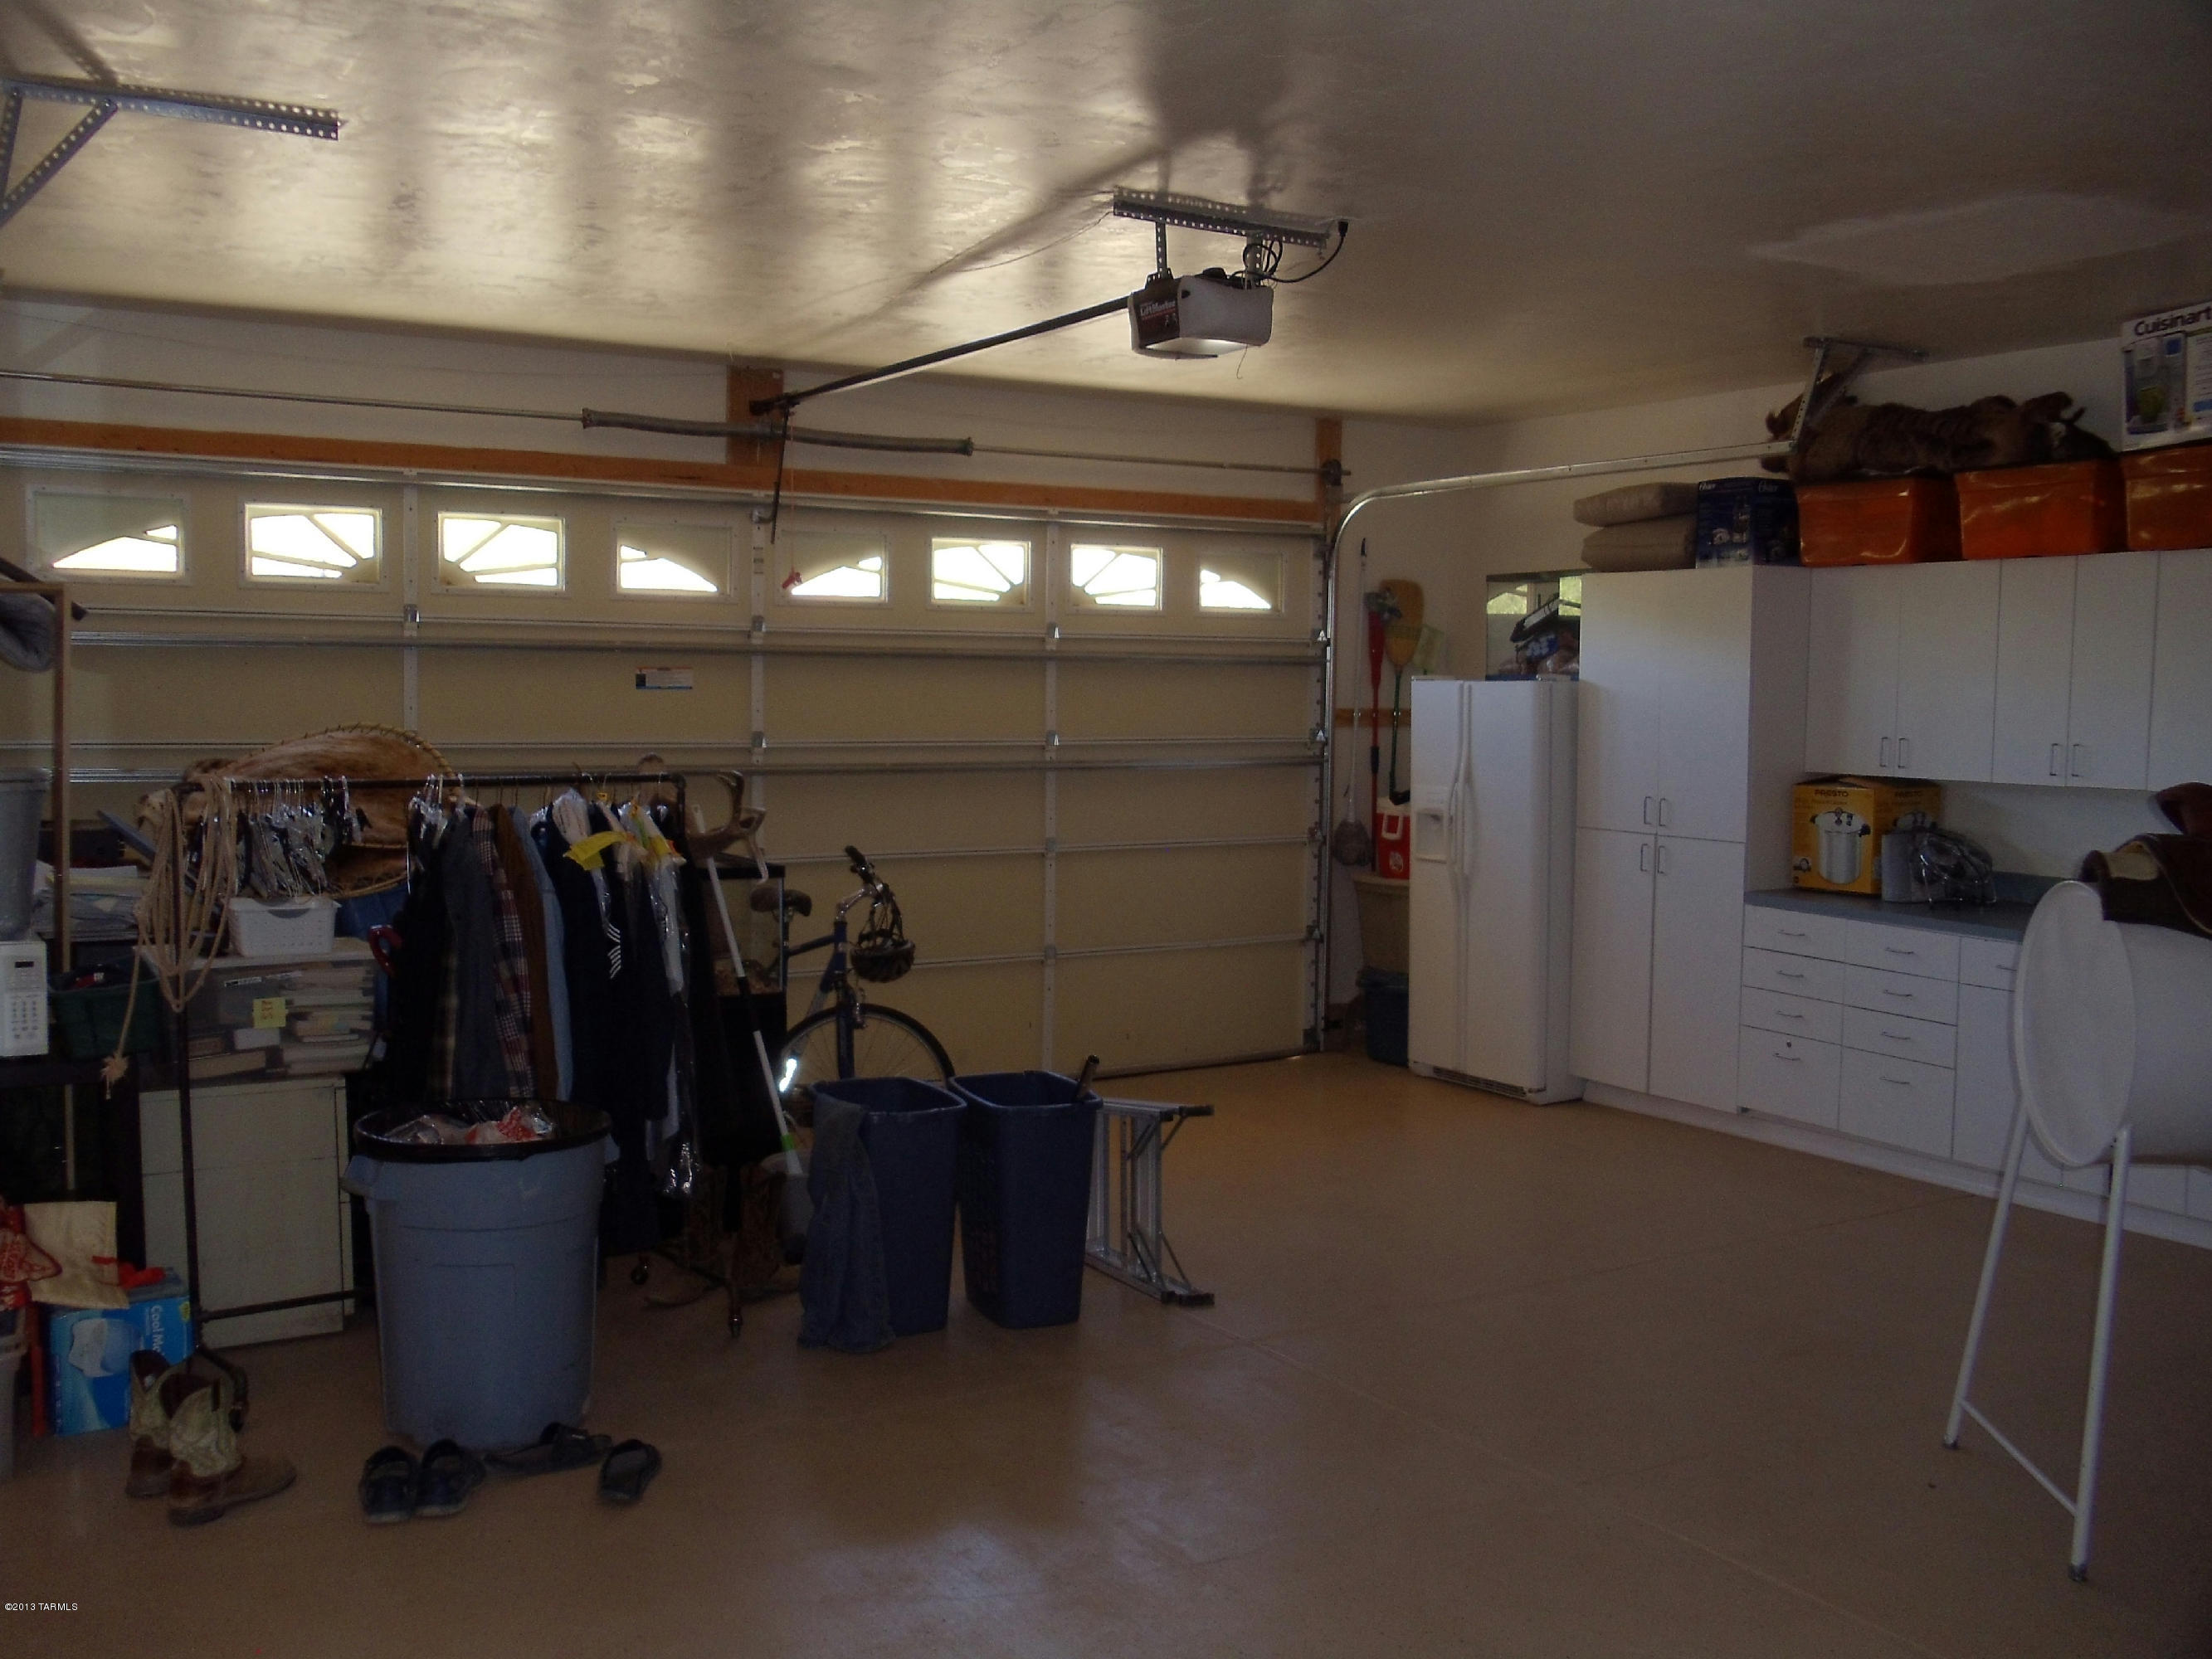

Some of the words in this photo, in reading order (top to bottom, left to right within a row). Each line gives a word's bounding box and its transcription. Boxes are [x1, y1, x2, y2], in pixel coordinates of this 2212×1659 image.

[2134, 305, 2212, 336] Cuisinart
[1815, 789, 1849, 797] PRESTO
[150, 1305, 165, 1332] Cool
